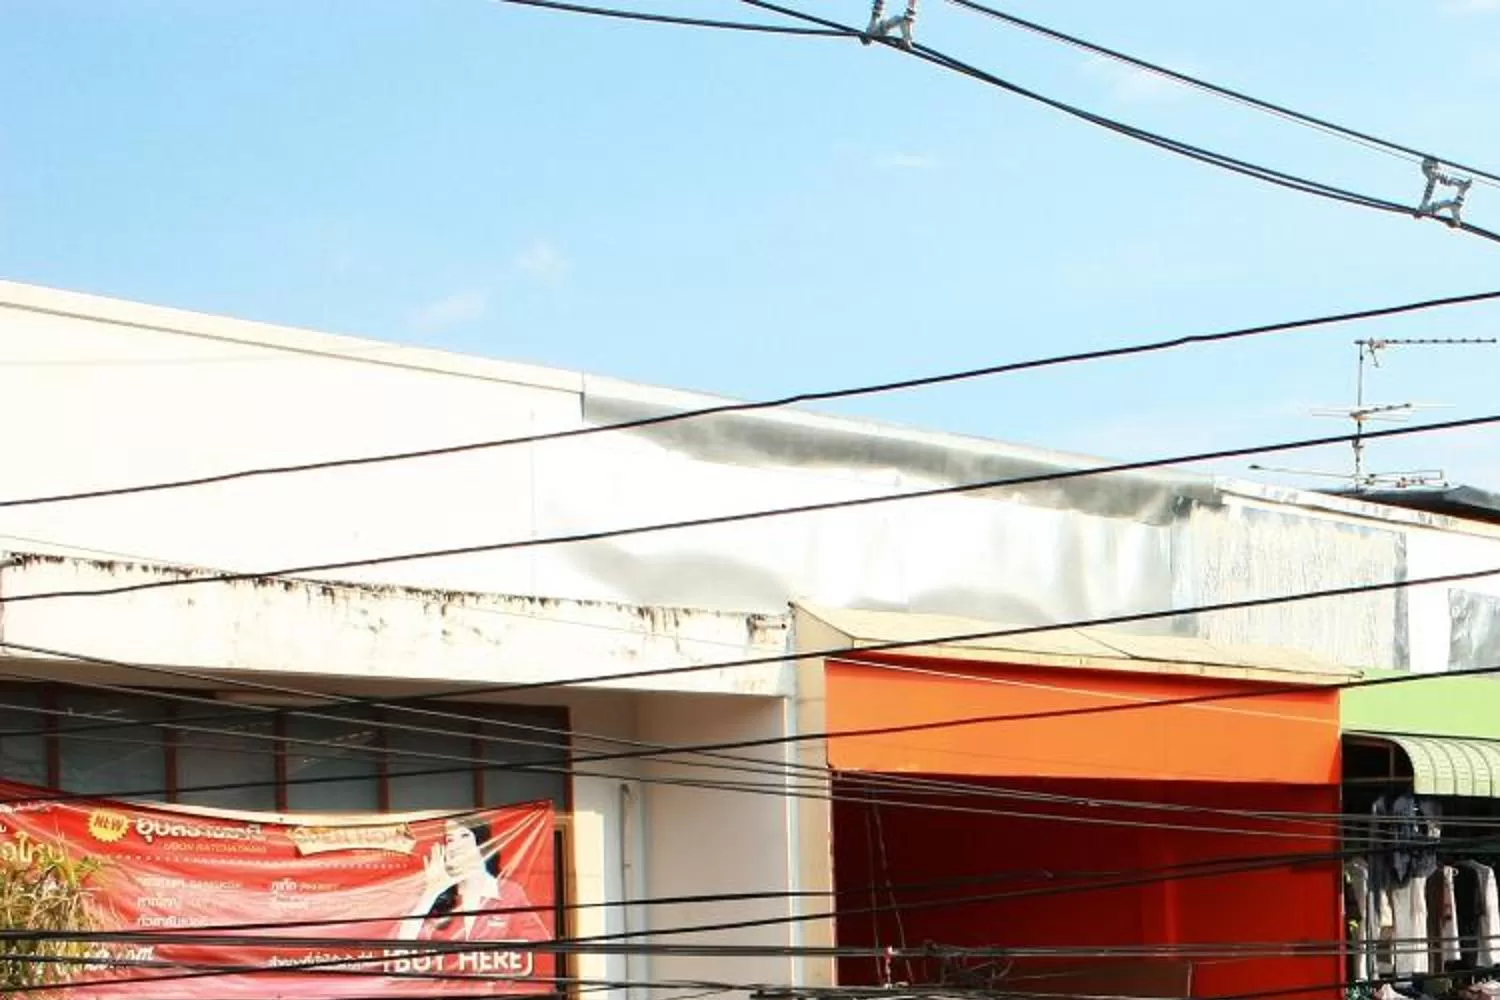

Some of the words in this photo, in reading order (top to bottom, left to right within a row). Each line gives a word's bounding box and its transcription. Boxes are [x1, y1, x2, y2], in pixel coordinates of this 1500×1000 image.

[94, 814, 125, 831] NEW
[395, 948, 447, 972] BUY
[459, 948, 523, 972] HERE
